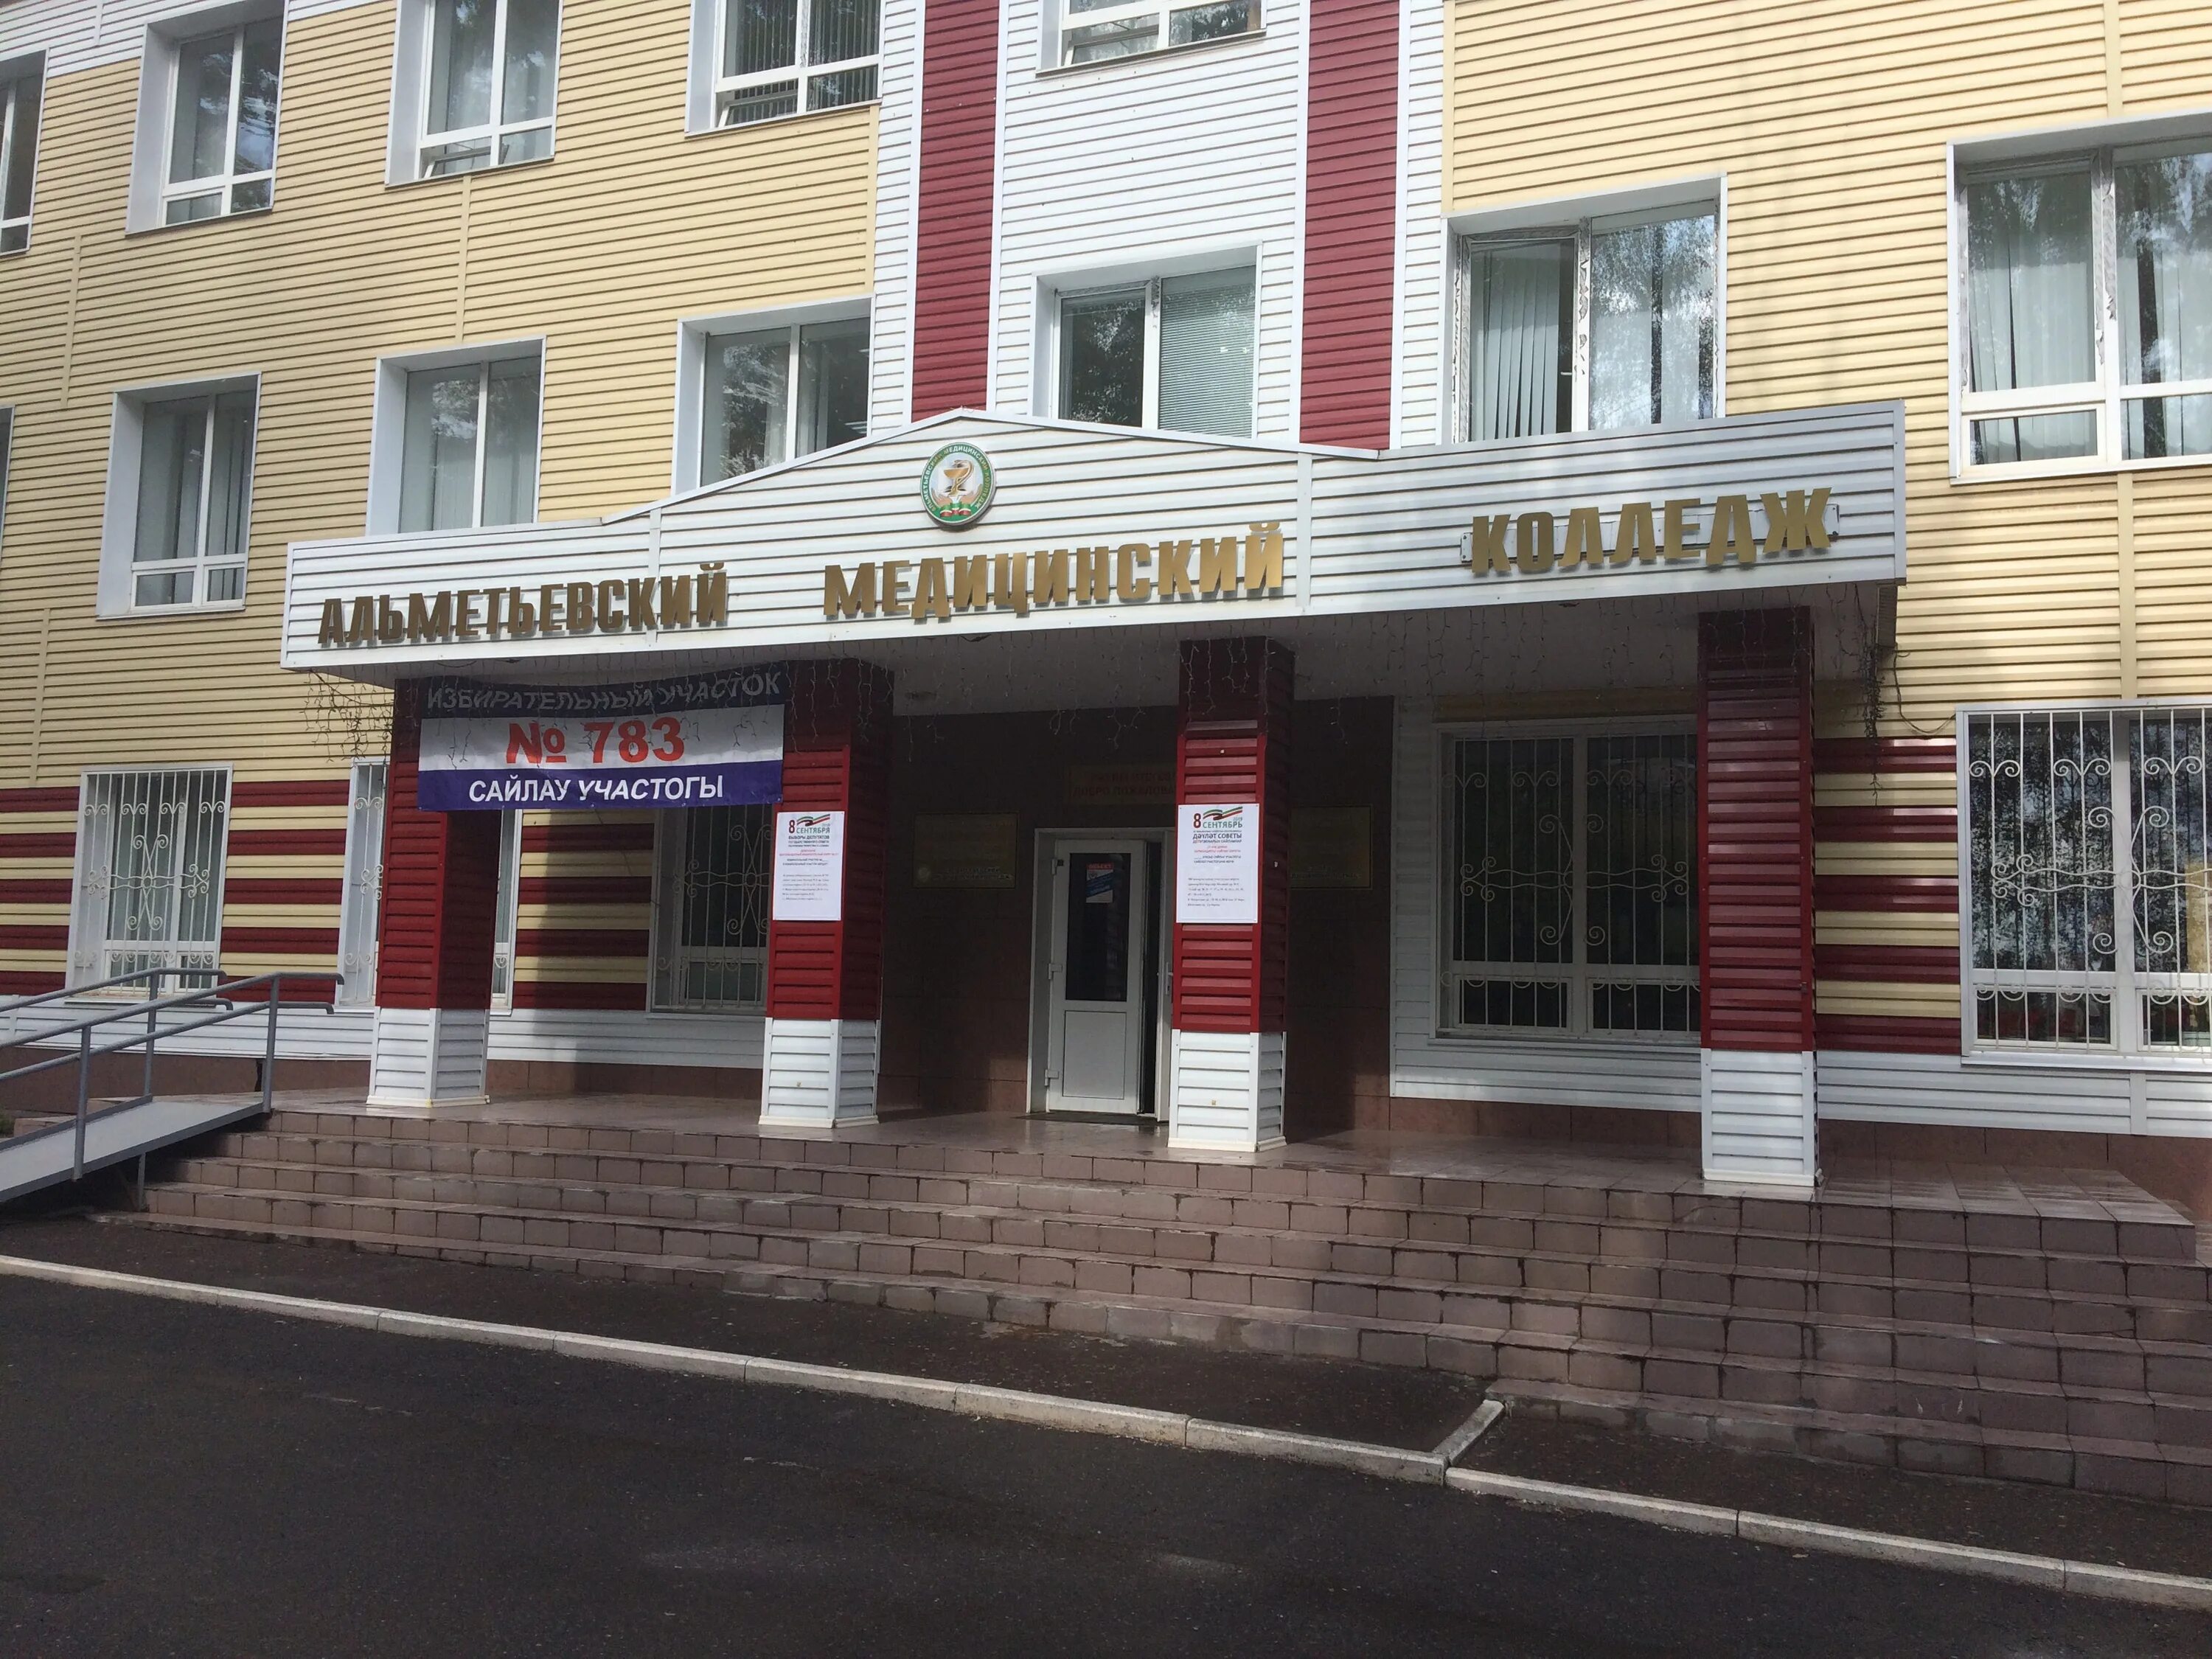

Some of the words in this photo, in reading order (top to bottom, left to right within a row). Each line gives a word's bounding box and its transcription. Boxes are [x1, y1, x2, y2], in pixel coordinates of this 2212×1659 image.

[318, 562, 727, 644] АЛЬМЕТЬЕВСКИЙ
[823, 521, 1283, 619] МЕДИЦИНСКИЙ
[1471, 487, 1833, 573] КОЛЛЕДЖ
[428, 683, 653, 711] ИЗБИРАТЕЛЬНЫЙ
[661, 670, 781, 706] УЧАСТОК
[506, 722, 567, 764] №
[583, 716, 686, 764] 783
[469, 773, 571, 802] САЙЛАУ
[579, 775, 723, 801] УЧАСТОГЫ
[788, 819, 796, 834] 8
[1193, 813, 1201, 829] 8
[1203, 821, 1243, 829] СЕНТЯБРЬ
